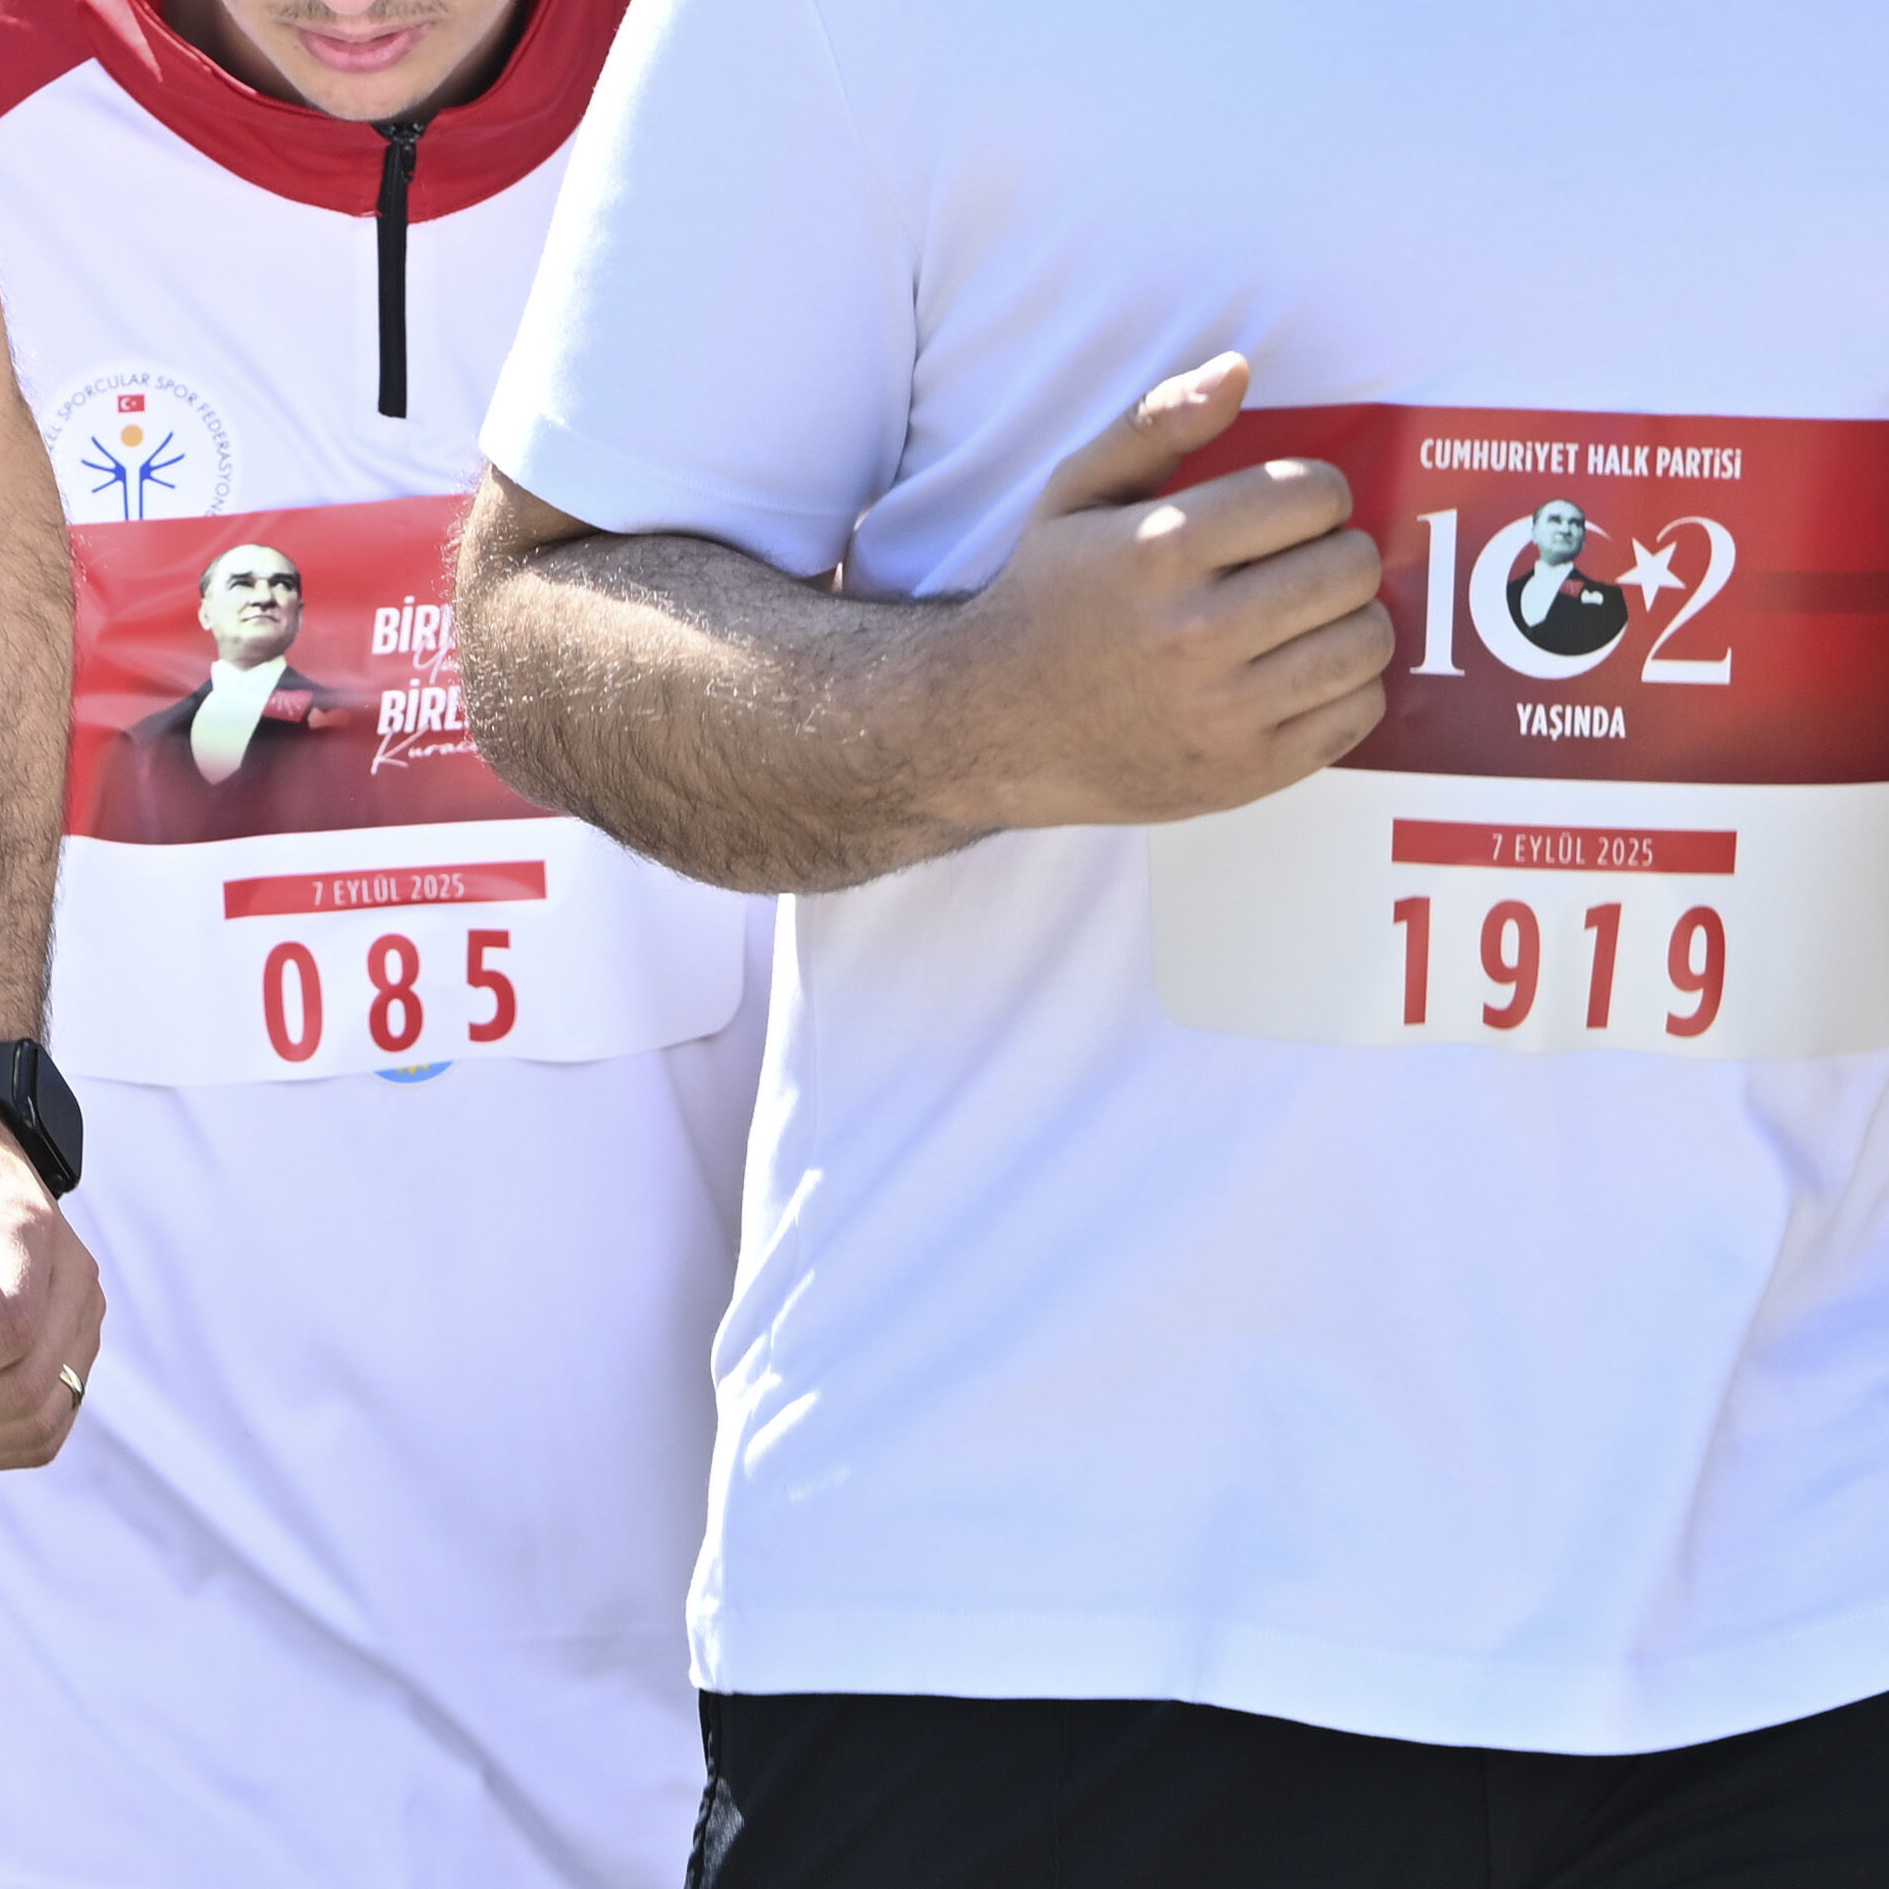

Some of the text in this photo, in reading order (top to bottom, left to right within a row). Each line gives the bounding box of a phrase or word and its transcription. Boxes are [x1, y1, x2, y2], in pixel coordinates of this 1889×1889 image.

[57, 373, 151, 421] SPORCULAR
[156, 375, 199, 406] SPOR
[1587, 444, 1650, 477] HALK
[1516, 702, 1627, 741] YAŞINDA
[1491, 831, 1654, 867] 7 EYLÜL 2025
[311, 873, 465, 907] 7 EYLÜL 2025
[1392, 894, 1727, 1039] 1919
[262, 928, 518, 1064] 085
